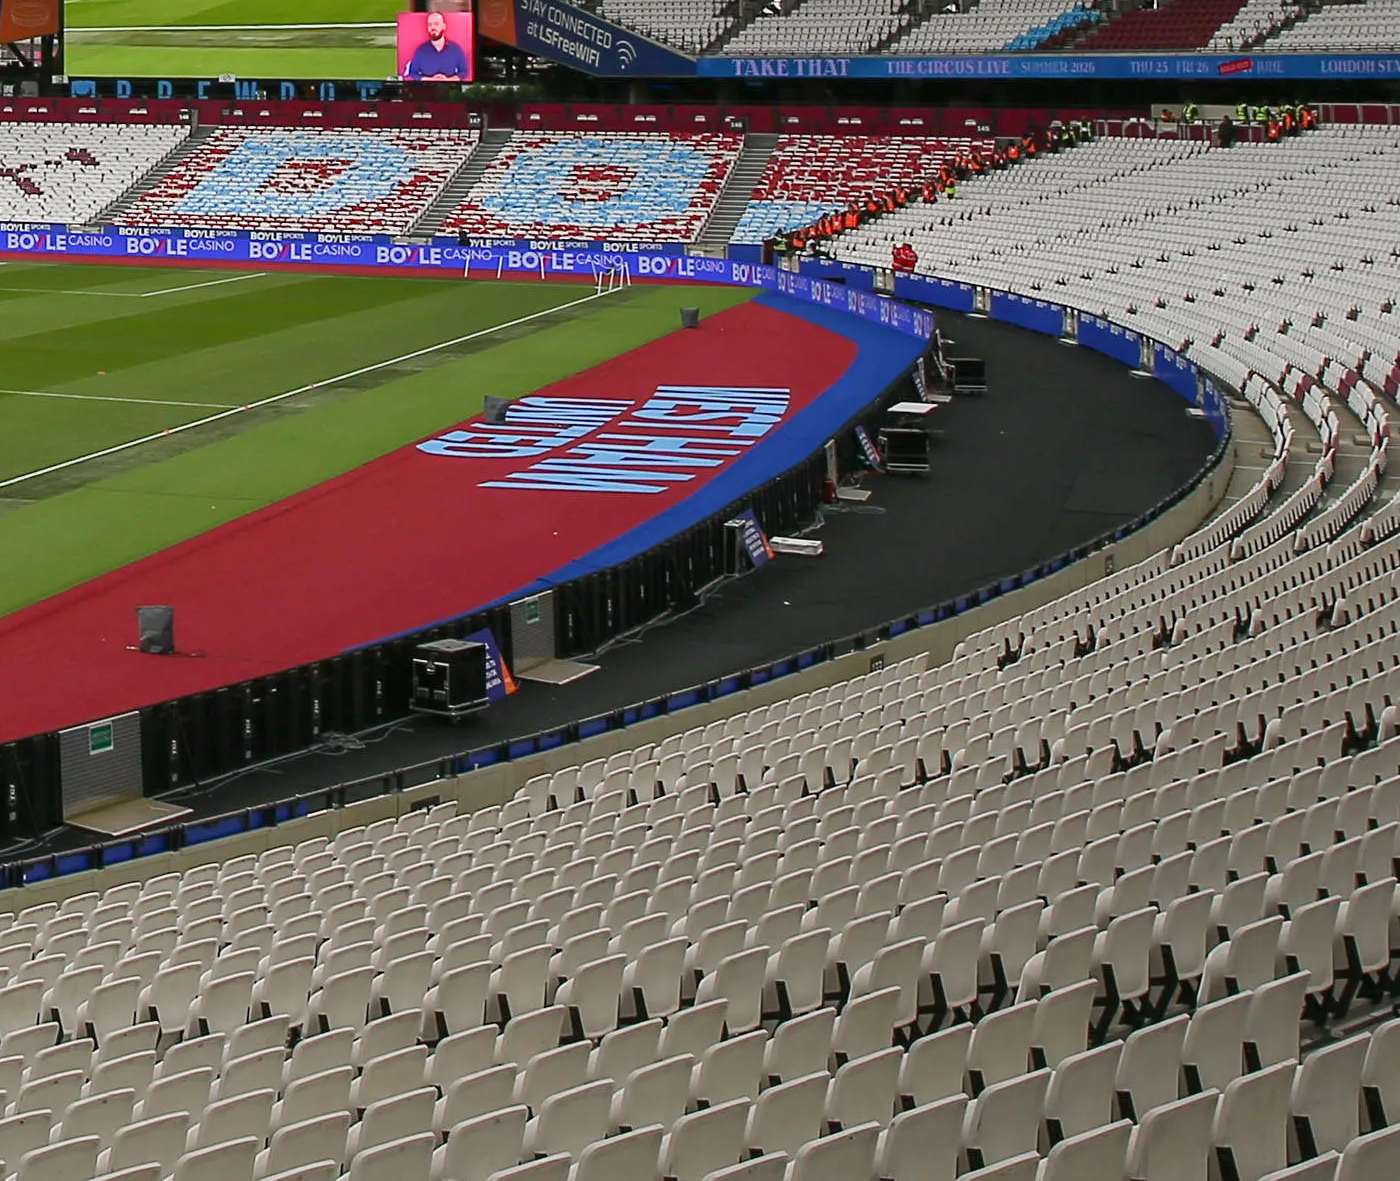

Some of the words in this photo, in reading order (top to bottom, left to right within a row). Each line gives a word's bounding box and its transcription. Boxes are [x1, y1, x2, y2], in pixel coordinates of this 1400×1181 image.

[526, 22, 536, 36] at
[547, 3, 612, 49] CONNECTED
[732, 59, 789, 76] TAKE
[794, 59, 850, 76] THAT
[886, 61, 916, 74] THE
[918, 61, 975, 74] CIRCUS
[978, 61, 1009, 74] LIVE
[1020, 61, 1068, 73] SUMMER
[1070, 62, 1096, 73] 2026
[1131, 61, 1153, 73] THU
[1196, 62, 1208, 73] 26
[1320, 59, 1375, 73] LONDON
[0, 223, 30, 231] BOYLE
[119, 227, 150, 237] BOYLE
[184, 229, 215, 239] BOYLE
[8, 233, 66, 251] BOYLE
[68, 235, 112, 247] CASINO
[251, 231, 282, 241] BOYLE
[318, 234, 350, 243] BOYLE
[126, 238, 187, 255] BOYLE
[189, 239, 234, 251] CASINO
[250, 242, 312, 260] BOYLE
[314, 244, 362, 257] CASINO
[530, 240, 564, 251] BOYLE
[604, 243, 638, 253] BOYLE
[376, 246, 442, 265] BOYLE
[443, 248, 492, 261] CASINO
[508, 251, 574, 270] BOYLE
[576, 253, 623, 266] CASINO
[638, 256, 695, 276] BOYLE
[695, 259, 725, 273] CASINO
[732, 263, 762, 285] BOYLE
[618, 385, 792, 436] WEST
[416, 396, 636, 458] UNITED
[477, 432, 758, 493] HAM
